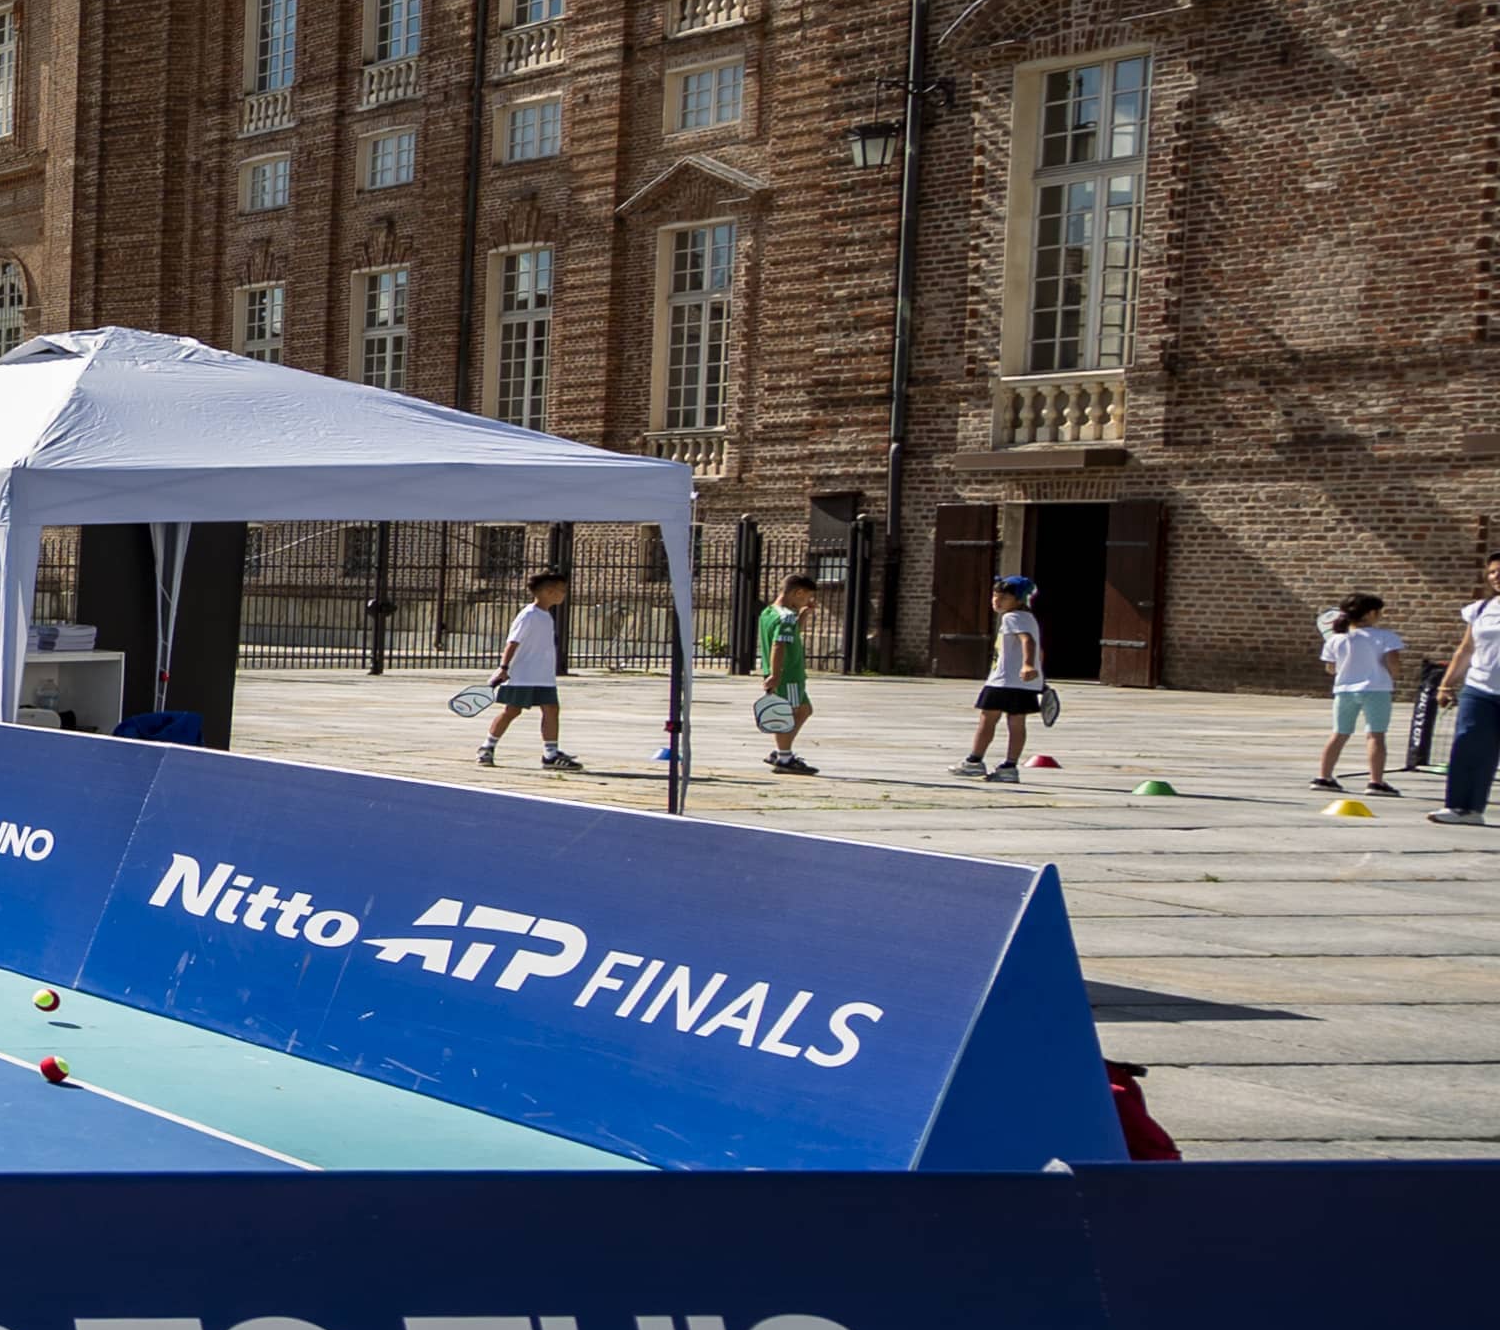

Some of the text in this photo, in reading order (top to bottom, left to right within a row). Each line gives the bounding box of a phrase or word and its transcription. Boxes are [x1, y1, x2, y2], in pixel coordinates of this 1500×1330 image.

[148, 853, 885, 1068] Nitto ATP FINALS
